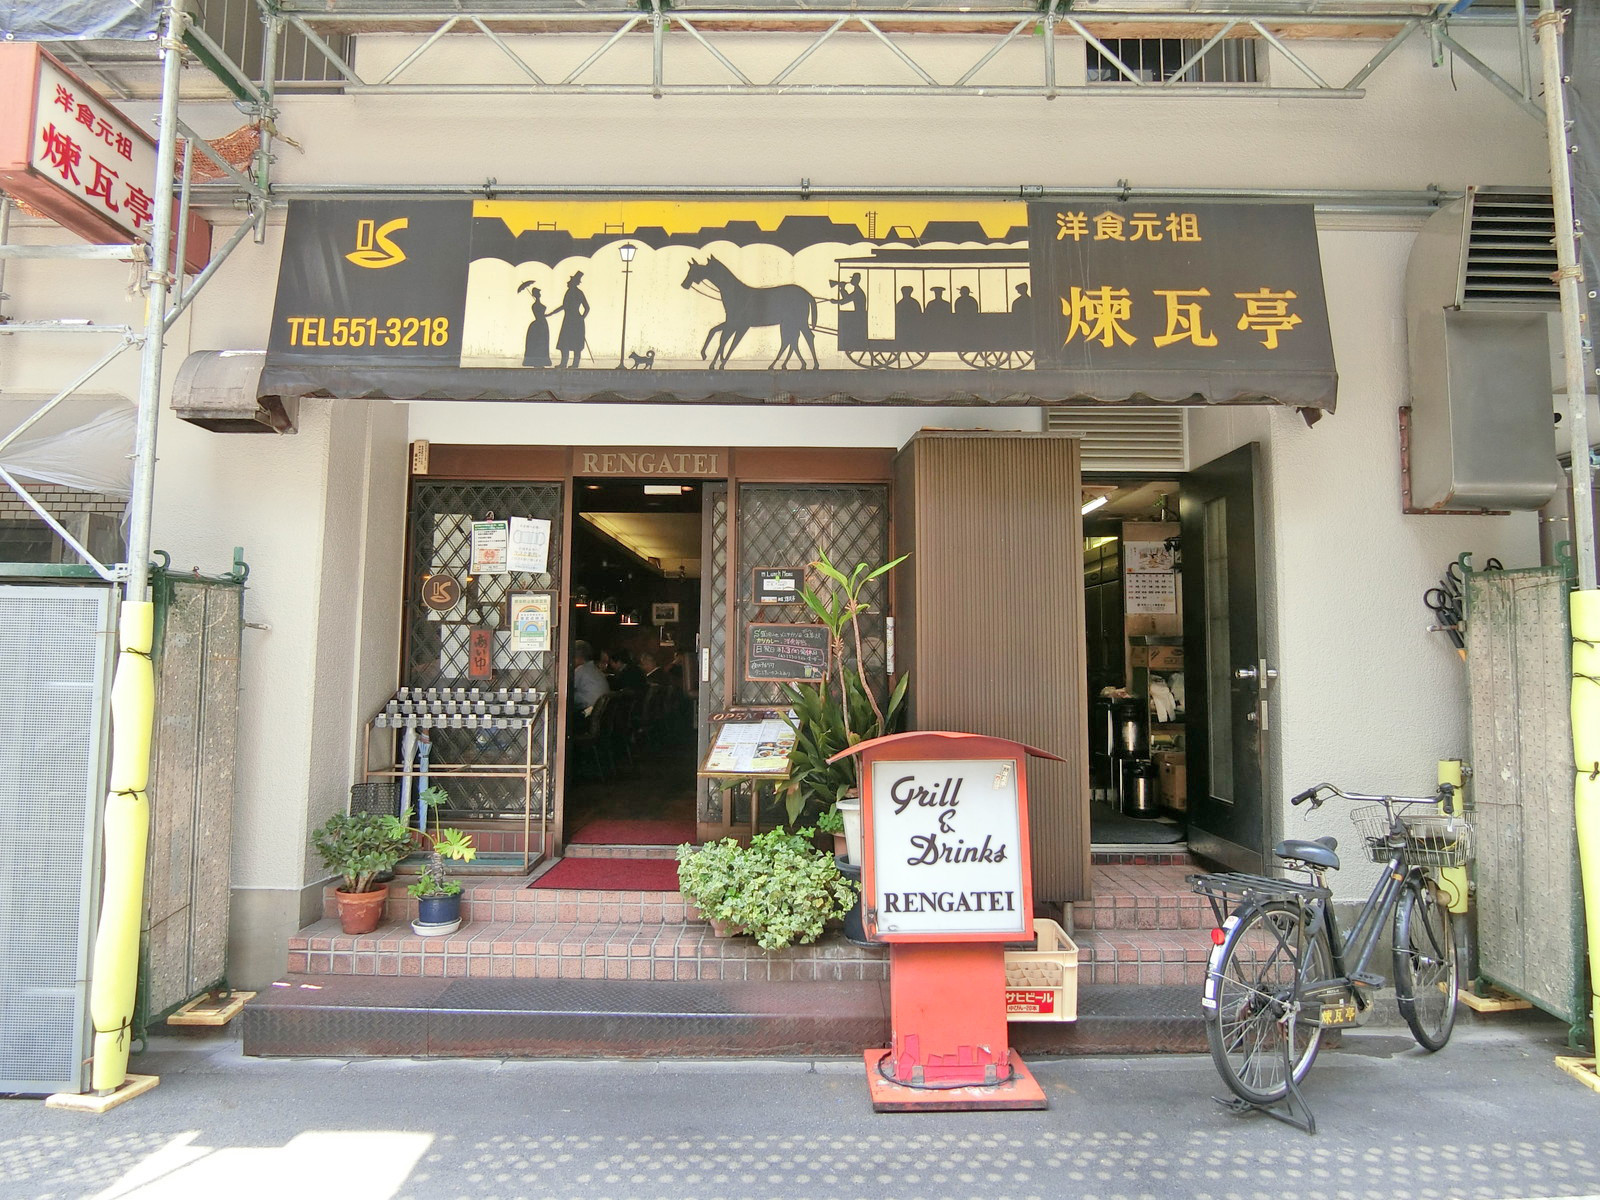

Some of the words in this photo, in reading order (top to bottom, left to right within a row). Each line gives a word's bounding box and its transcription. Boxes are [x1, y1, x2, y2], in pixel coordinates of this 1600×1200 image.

[54, 84, 133, 162] 洋食元祖
[41, 122, 154, 228] 煉瓦亭
[1056, 210, 1202, 242] 洋食元祖
[1059, 285, 1304, 351] 煉瓦亭
[582, 453, 718, 474] RENGATEI
[891, 776, 963, 815] Grill
[938, 809, 955, 833] &
[907, 834, 1008, 866] Drinks
[884, 891, 1015, 913] RENGATEI
[1321, 1007, 1355, 1025] 煉瓦亭
